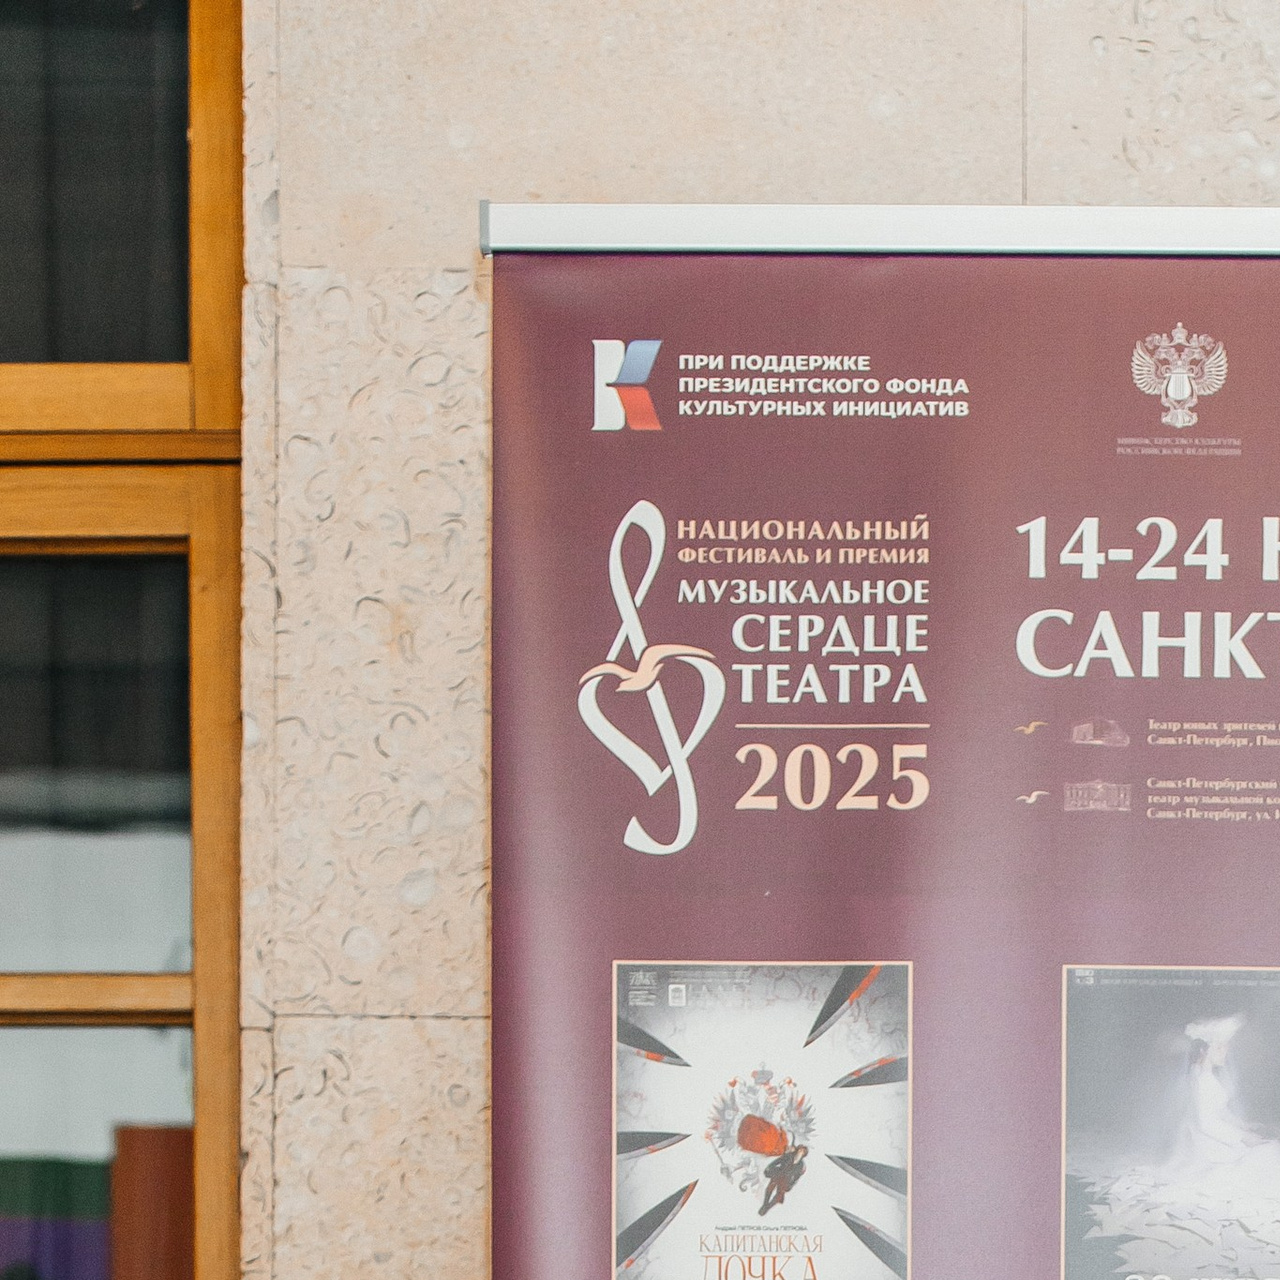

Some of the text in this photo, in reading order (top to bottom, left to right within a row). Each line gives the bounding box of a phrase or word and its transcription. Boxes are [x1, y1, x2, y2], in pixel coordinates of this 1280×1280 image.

[679, 355, 870, 373] ПРИ ПОДДЕРЖКЕ
[679, 377, 969, 396] ПРЕЗИДЕНТСКОГО ФОНДА
[679, 400, 969, 418] КУЛЬТУРНЫХ ИНИЦИАТИВ
[678, 513, 929, 541] НАЦИОНАЛЬНЫЙ
[678, 548, 929, 564] ФЕСТИВАЛЬ И ПРЕМИЯ
[1016, 516, 1229, 580] 14-24
[678, 579, 929, 604] МУЗЫКАЛЬНОЕ
[732, 614, 928, 656] СЕРДЦЕ
[732, 664, 927, 703] ТЕАТРА
[735, 744, 930, 810] 2025
[699, 1234, 824, 1253] КАПИТАНСКАЯ
